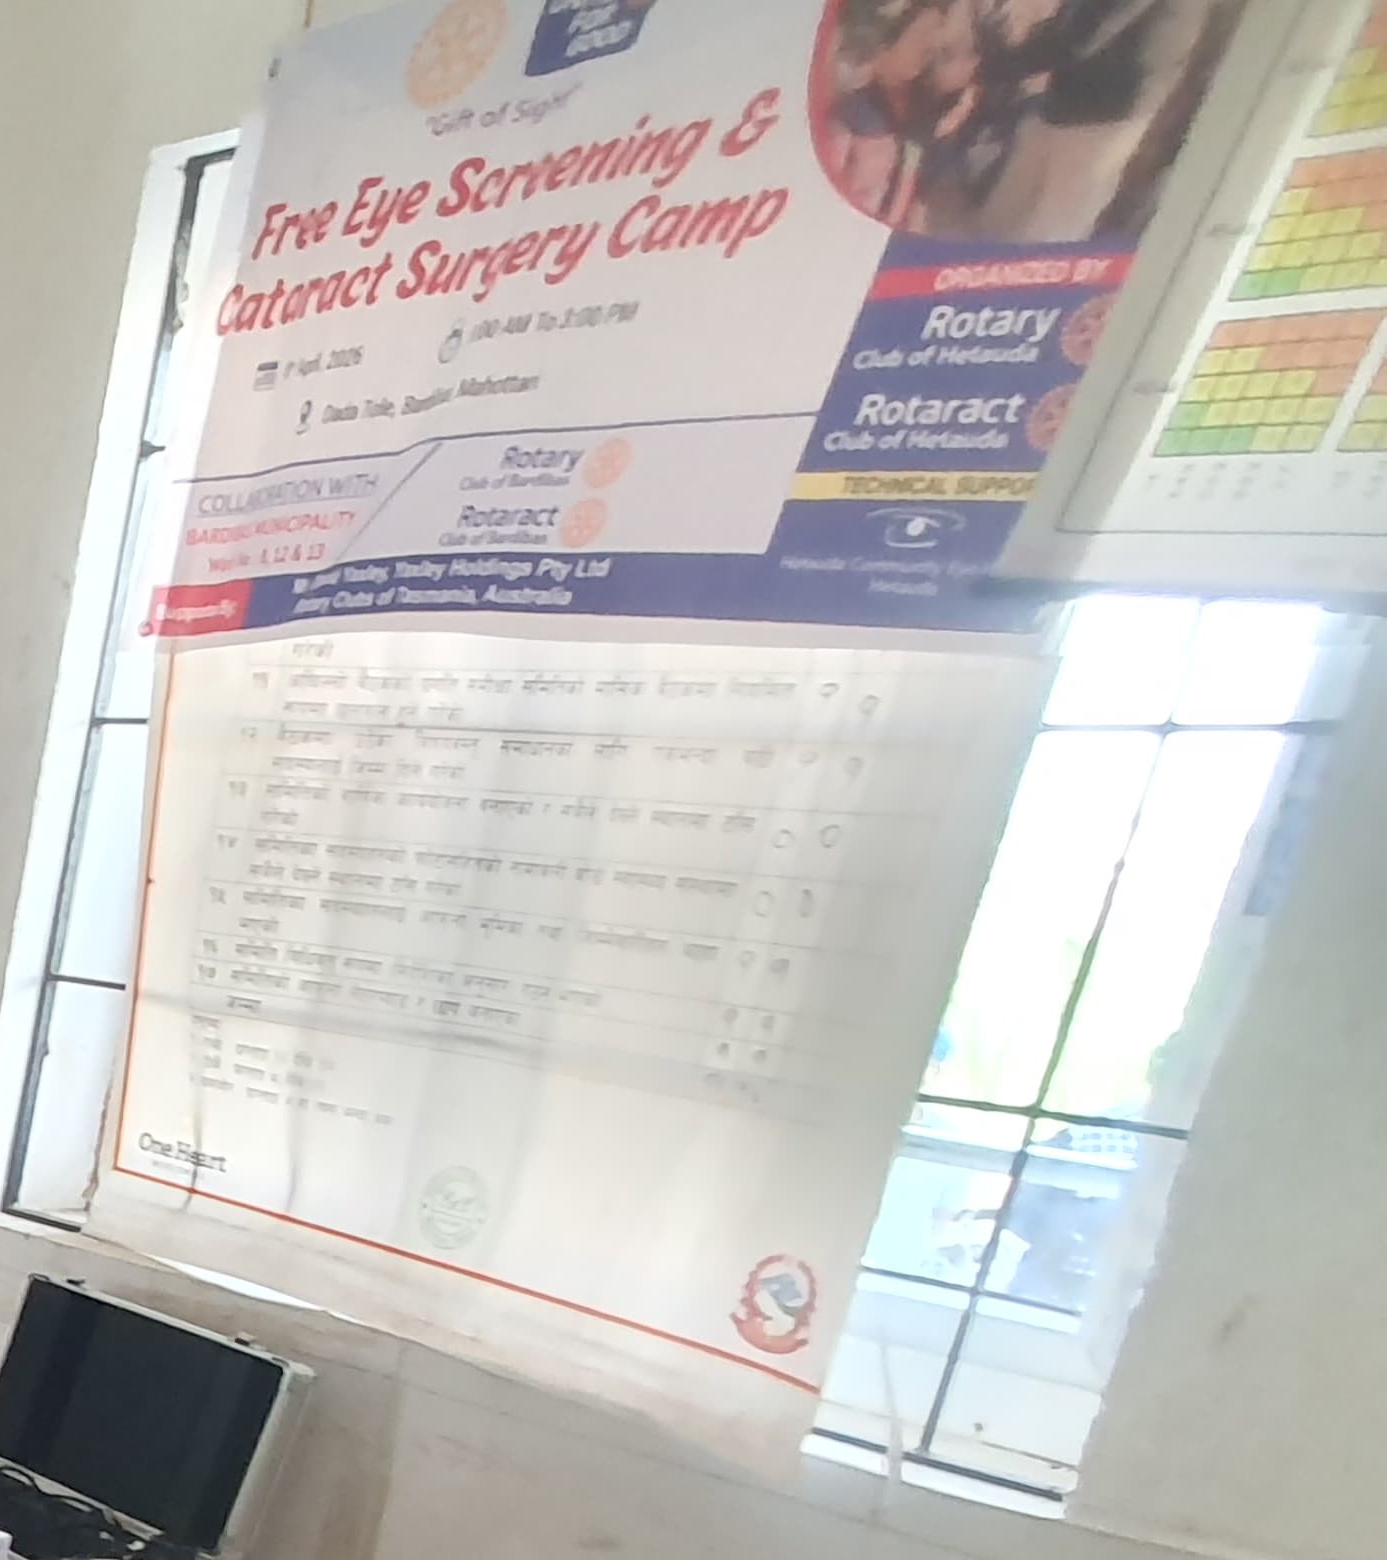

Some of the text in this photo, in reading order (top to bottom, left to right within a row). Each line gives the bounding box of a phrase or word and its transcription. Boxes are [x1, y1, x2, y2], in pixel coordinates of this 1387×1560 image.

[479, 101, 511, 128] of
[251, 86, 782, 261] Free Eye Screening &
[216, 187, 789, 337] Cataract Surgery Camp
[934, 258, 1113, 291] ORGANIZED BY
[920, 304, 1063, 342] Rotary
[852, 343, 1039, 371] Club of Hetauda
[853, 393, 1026, 427] Rotaract
[823, 432, 876, 452] Club
[877, 429, 908, 450] of
[500, 444, 585, 473] Rotary
[843, 475, 948, 496] TECHNICAL
[457, 504, 561, 529] Rotaract
[447, 559, 534, 582] Holdings
[572, 558, 613, 578] Ltd
[139, 1132, 172, 1157] One
